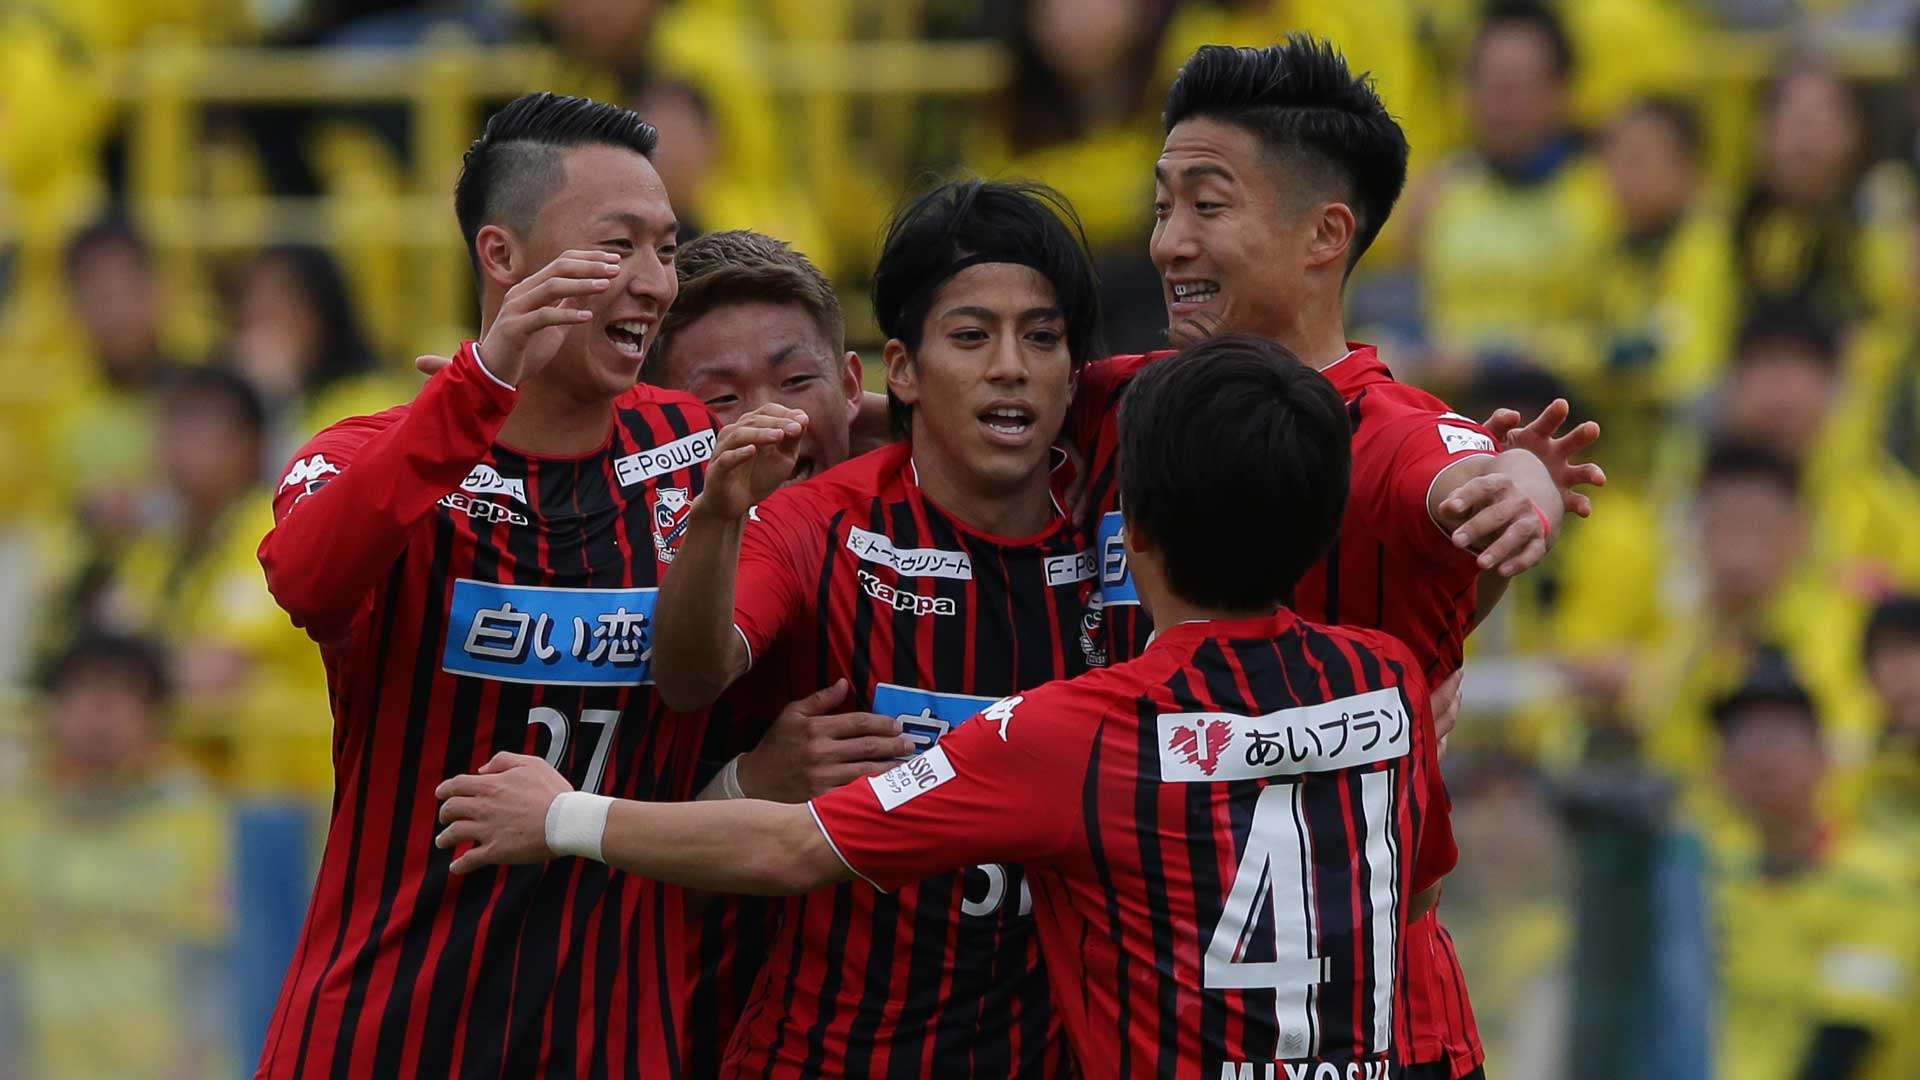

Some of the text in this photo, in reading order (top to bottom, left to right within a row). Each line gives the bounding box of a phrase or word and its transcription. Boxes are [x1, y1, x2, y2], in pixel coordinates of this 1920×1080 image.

[616, 435, 713, 483] F-Power
[857, 569, 956, 616] Kappa
[463, 601, 652, 662] 白い恋
[1244, 708, 1402, 767] あいプラン
[907, 755, 938, 788] SSIC
[1203, 768, 1398, 1060] 41
